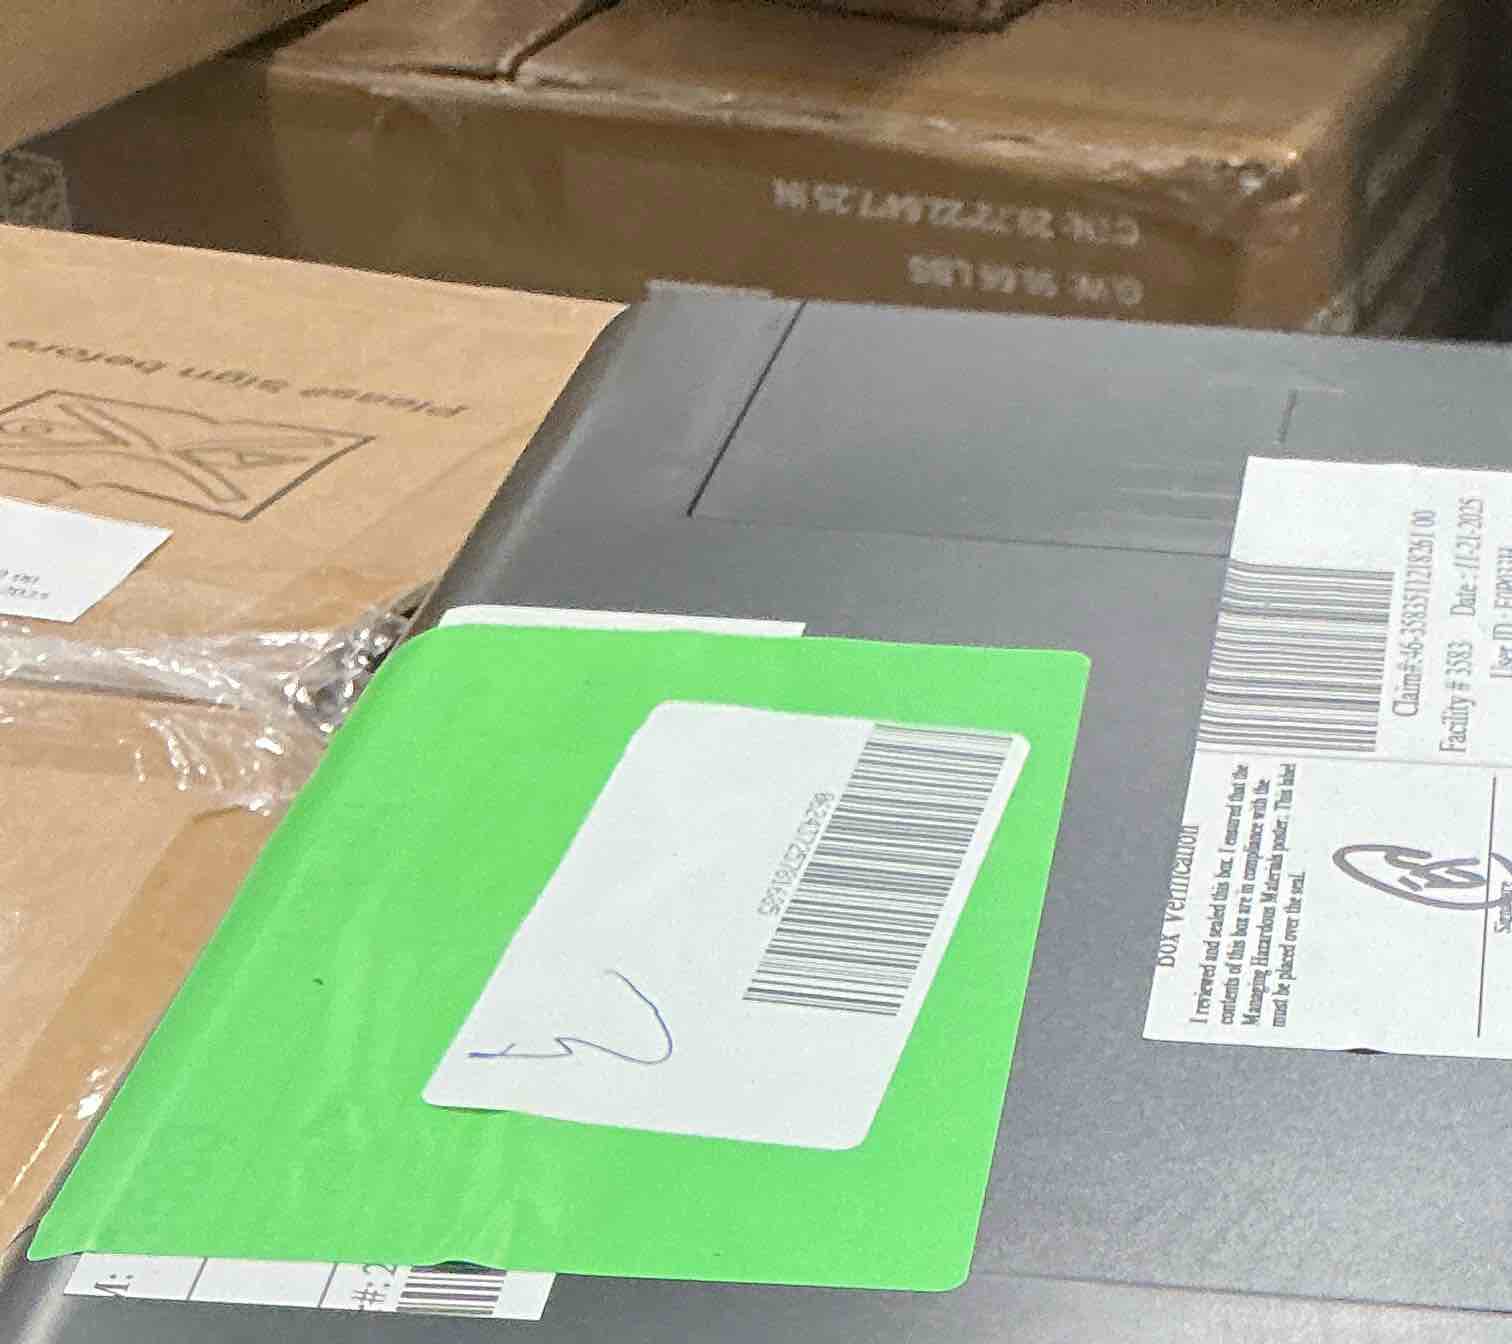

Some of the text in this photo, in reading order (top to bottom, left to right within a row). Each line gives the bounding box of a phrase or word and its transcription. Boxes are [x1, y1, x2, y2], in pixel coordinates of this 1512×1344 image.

[1454, 496, 1483, 570] 11-21-2025
[1449, 584, 1477, 616] Date
[1446, 640, 1473, 676] 3583
[1438, 695, 1475, 753] Facility
[1232, 764, 1249, 780] the
[1278, 763, 1296, 786] label
[1228, 781, 1245, 801] that
[1274, 789, 1293, 812] This
[1212, 882, 1229, 901] this
[1261, 854, 1283, 904] Materials
[1221, 779, 1270, 1025] contents of this box are in compliance with the
[1207, 904, 1226, 937] sealed
[1250, 906, 1276, 967] Hazardous
[1204, 940, 1220, 961] and
[1271, 871, 1305, 1028] must be placed over the seal.
[1193, 965, 1215, 1015] reviewed
[1241, 969, 1271, 1026] Managing
